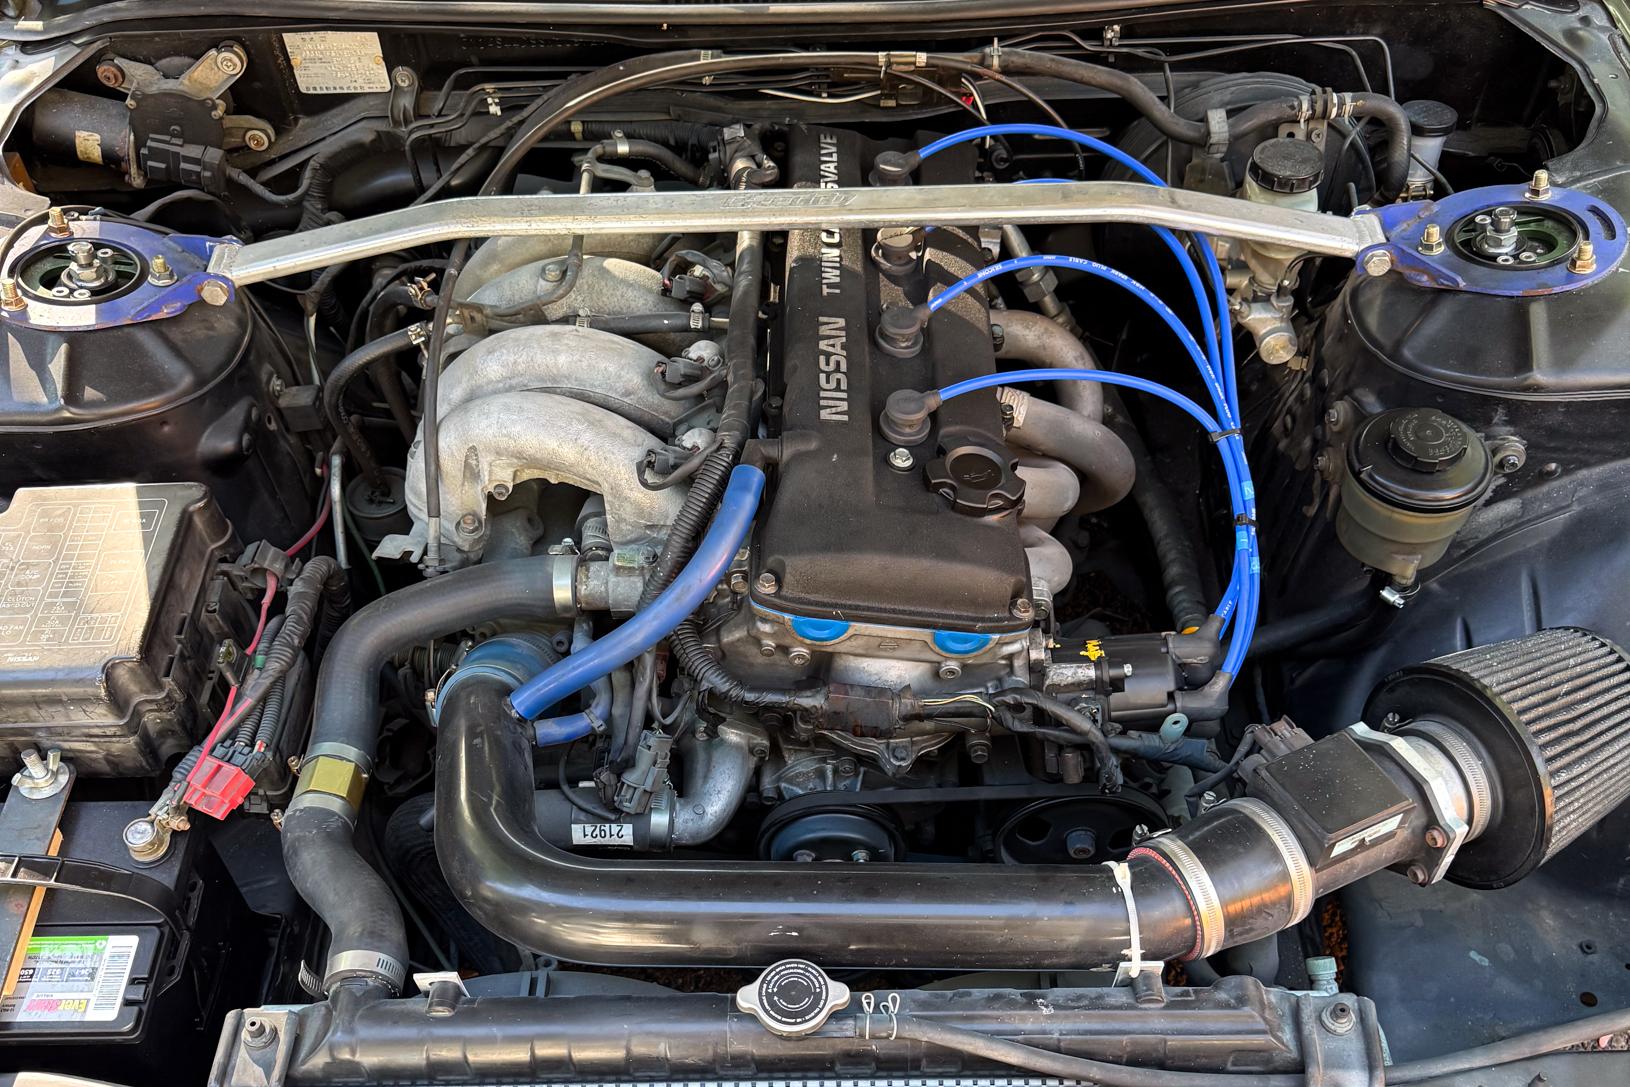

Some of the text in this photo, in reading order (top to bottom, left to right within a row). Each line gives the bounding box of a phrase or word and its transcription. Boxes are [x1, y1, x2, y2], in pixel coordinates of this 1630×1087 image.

[821, 248, 841, 296] TWIN
[818, 316, 849, 422] NISSAN
[7, 655, 40, 663] NISSAN
[583, 824, 624, 839] 21921
